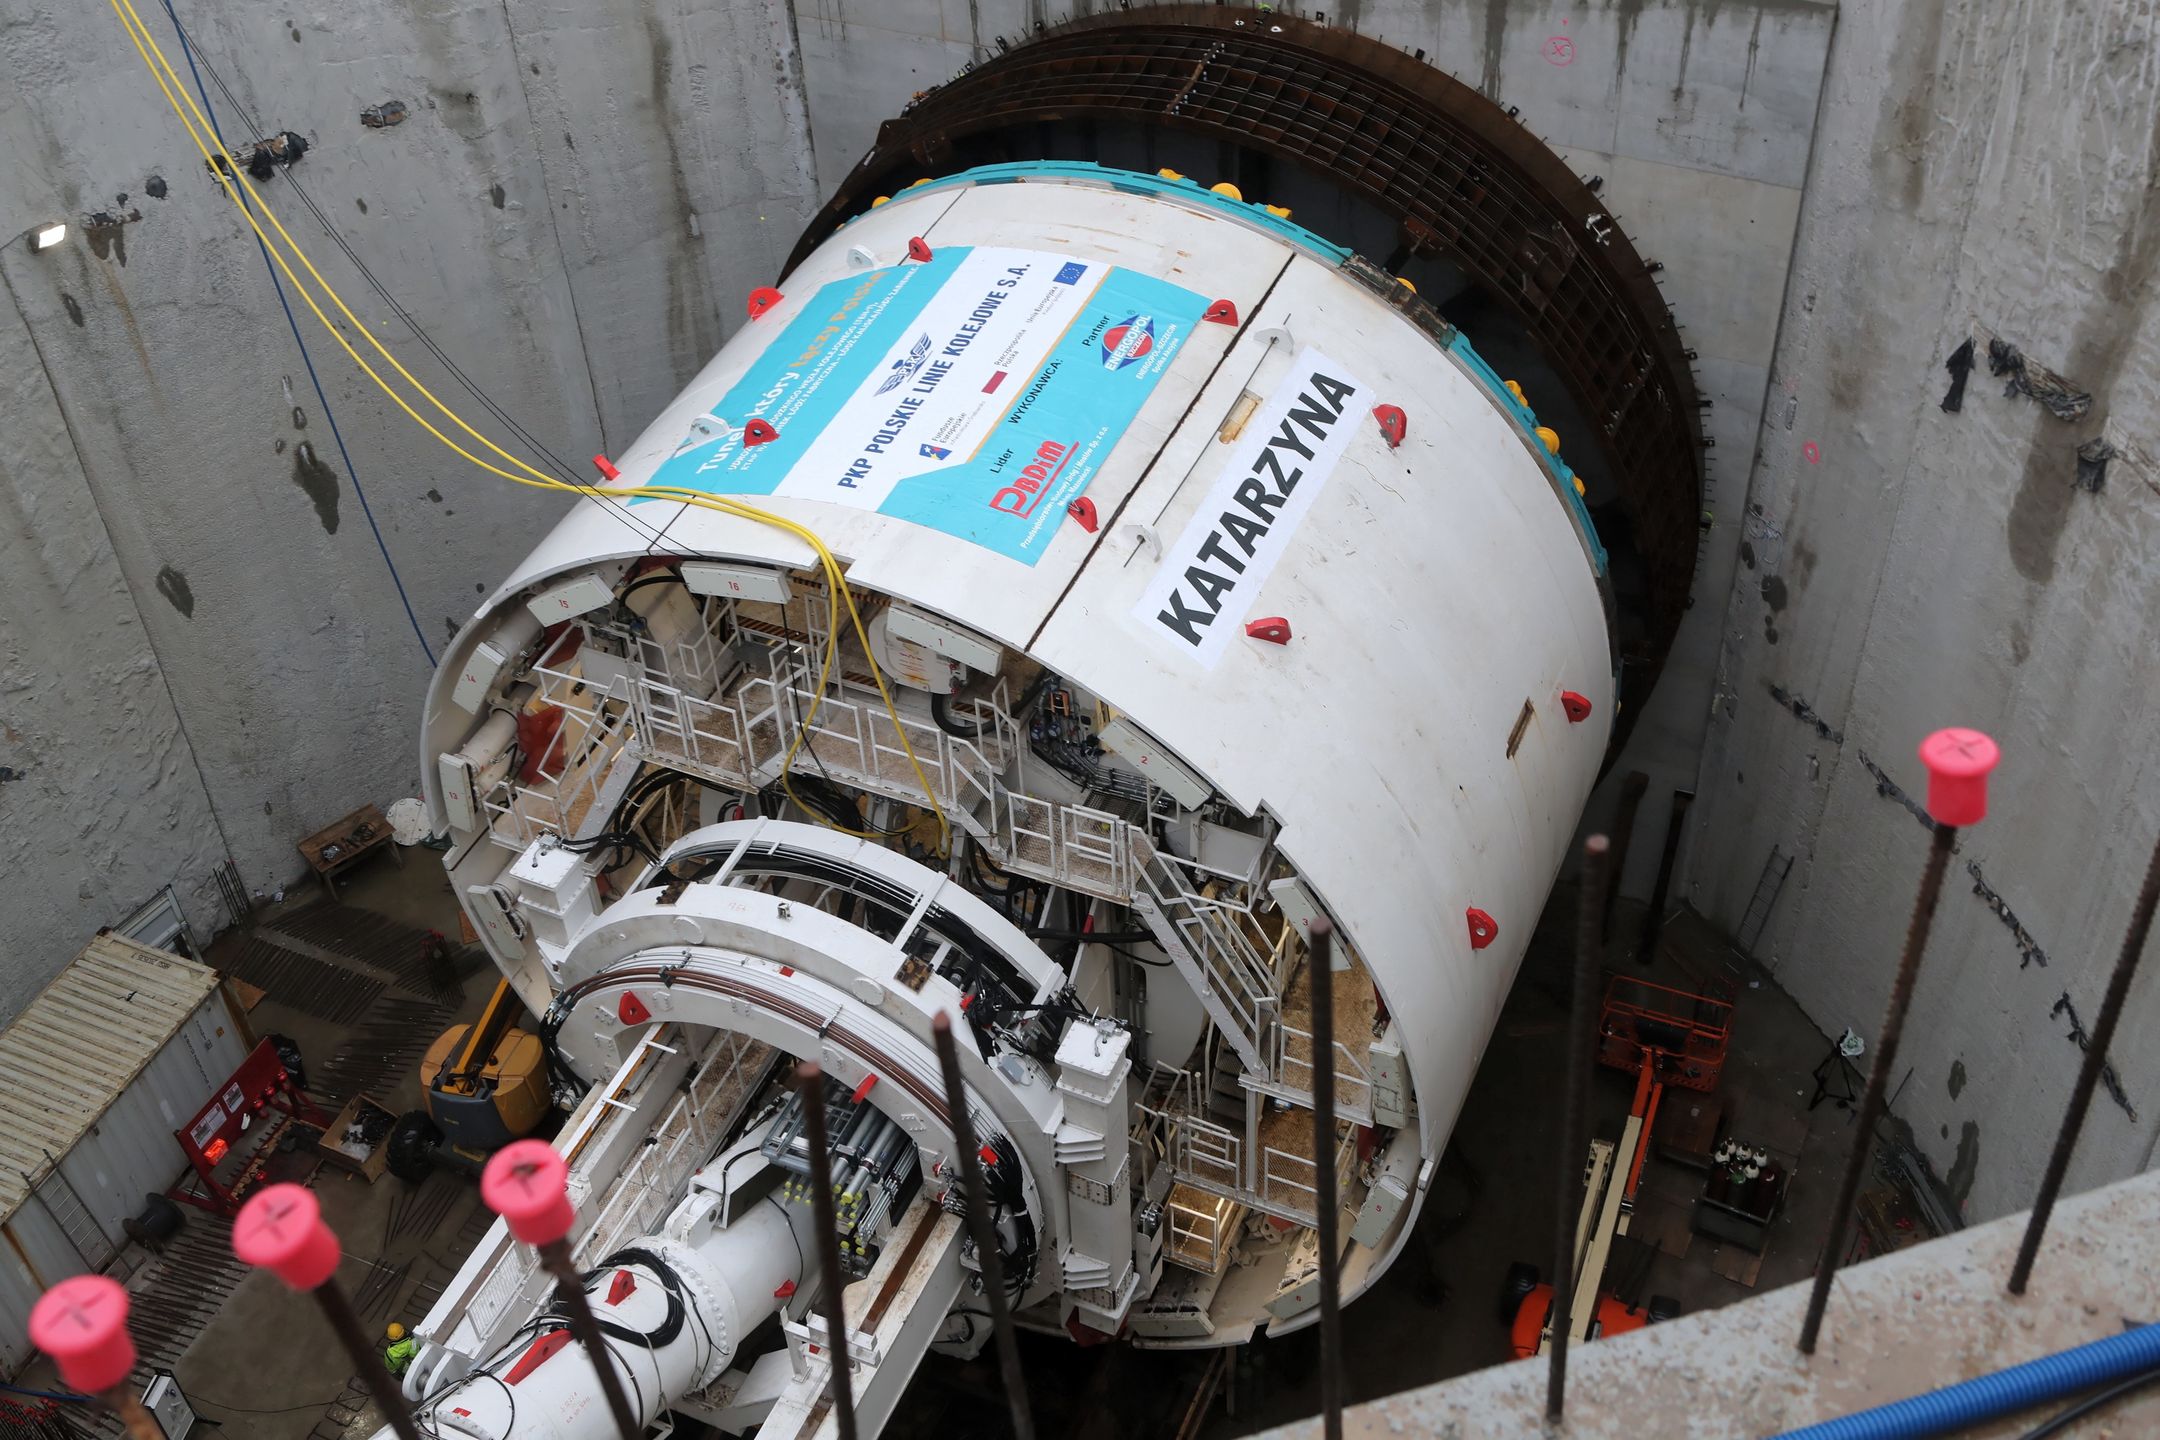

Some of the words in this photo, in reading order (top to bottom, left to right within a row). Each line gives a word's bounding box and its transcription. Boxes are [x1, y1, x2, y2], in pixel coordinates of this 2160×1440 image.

[1082, 315, 1111, 347] Partner
[1104, 314, 1152, 372] ENERGOPOL
[837, 457, 873, 489] PKP
[864, 397, 925, 454] POLSKIE
[912, 360, 954, 393] LINIE
[942, 291, 1008, 357] KOLEJOWE
[996, 263, 1031, 288] S.A.
[744, 372, 800, 417] który
[1008, 358, 1064, 425] WYKONAWCA:
[990, 448, 1014, 474] Lider
[1156, 372, 1356, 647] KATARZYNA
[728, 580, 740, 592] 16
[558, 599, 570, 609] 15
[465, 673, 477, 684] 14
[1139, 755, 1149, 765] 2
[448, 790, 460, 801] 13
[1302, 918, 1309, 926] 3
